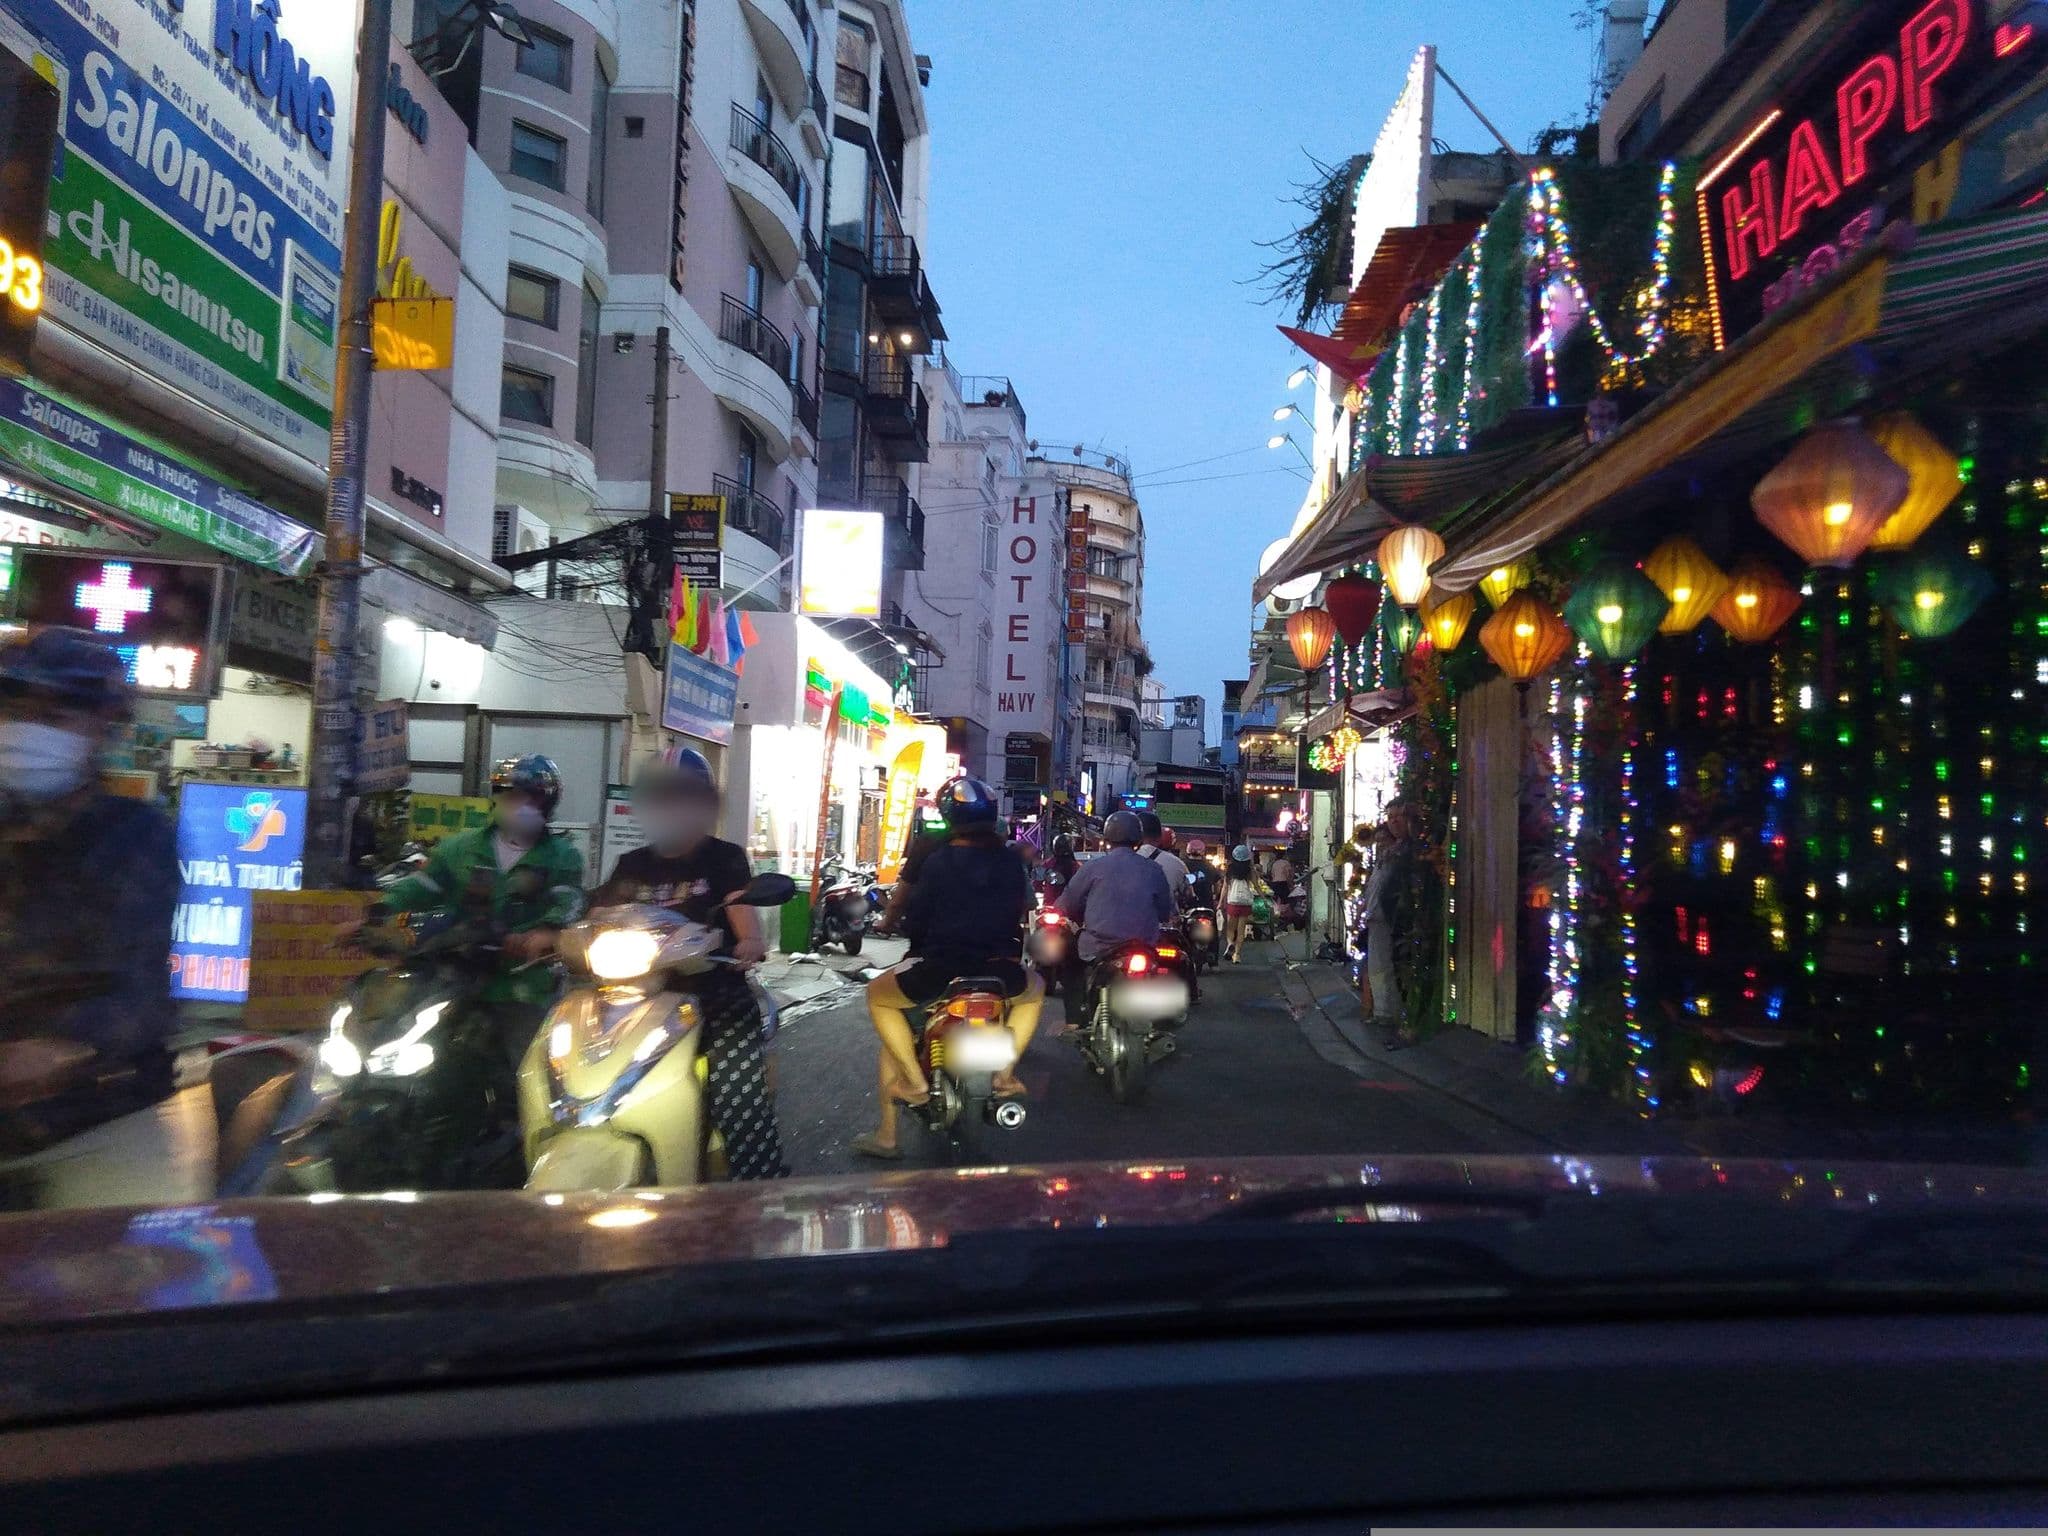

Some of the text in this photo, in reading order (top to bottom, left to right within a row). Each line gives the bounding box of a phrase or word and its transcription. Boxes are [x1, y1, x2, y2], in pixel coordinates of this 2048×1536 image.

[75, 50, 276, 261] Salonpas
[66, 199, 266, 364] Hisamitsu
[20, 391, 102, 448] Salonpas
[1006, 496, 1037, 681] HOTEL
[1069, 511, 1088, 628] HOSTEL
